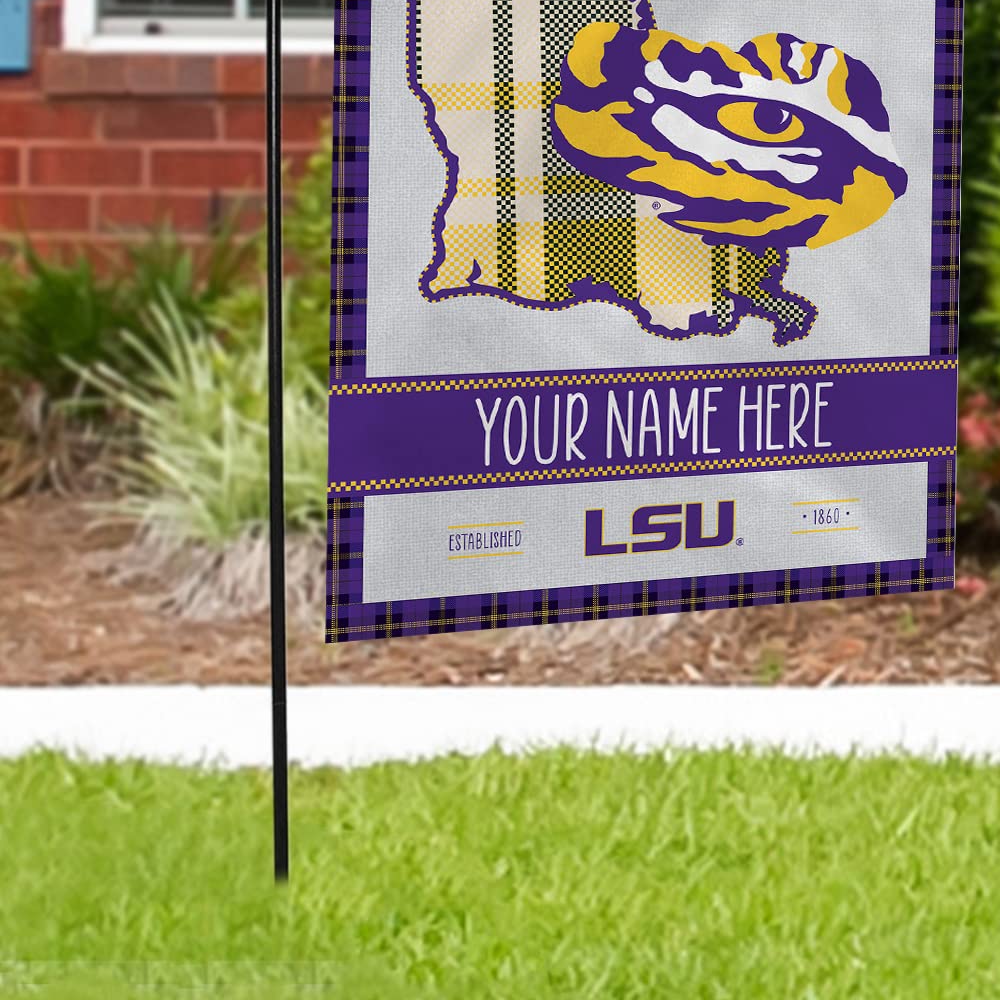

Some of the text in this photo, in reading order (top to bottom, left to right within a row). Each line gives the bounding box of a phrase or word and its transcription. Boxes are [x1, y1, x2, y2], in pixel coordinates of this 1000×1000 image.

[475, 381, 835, 466] YOUR NAME HERE
[812, 507, 841, 526] 1860
[448, 529, 523, 552] ESTABLISHED
